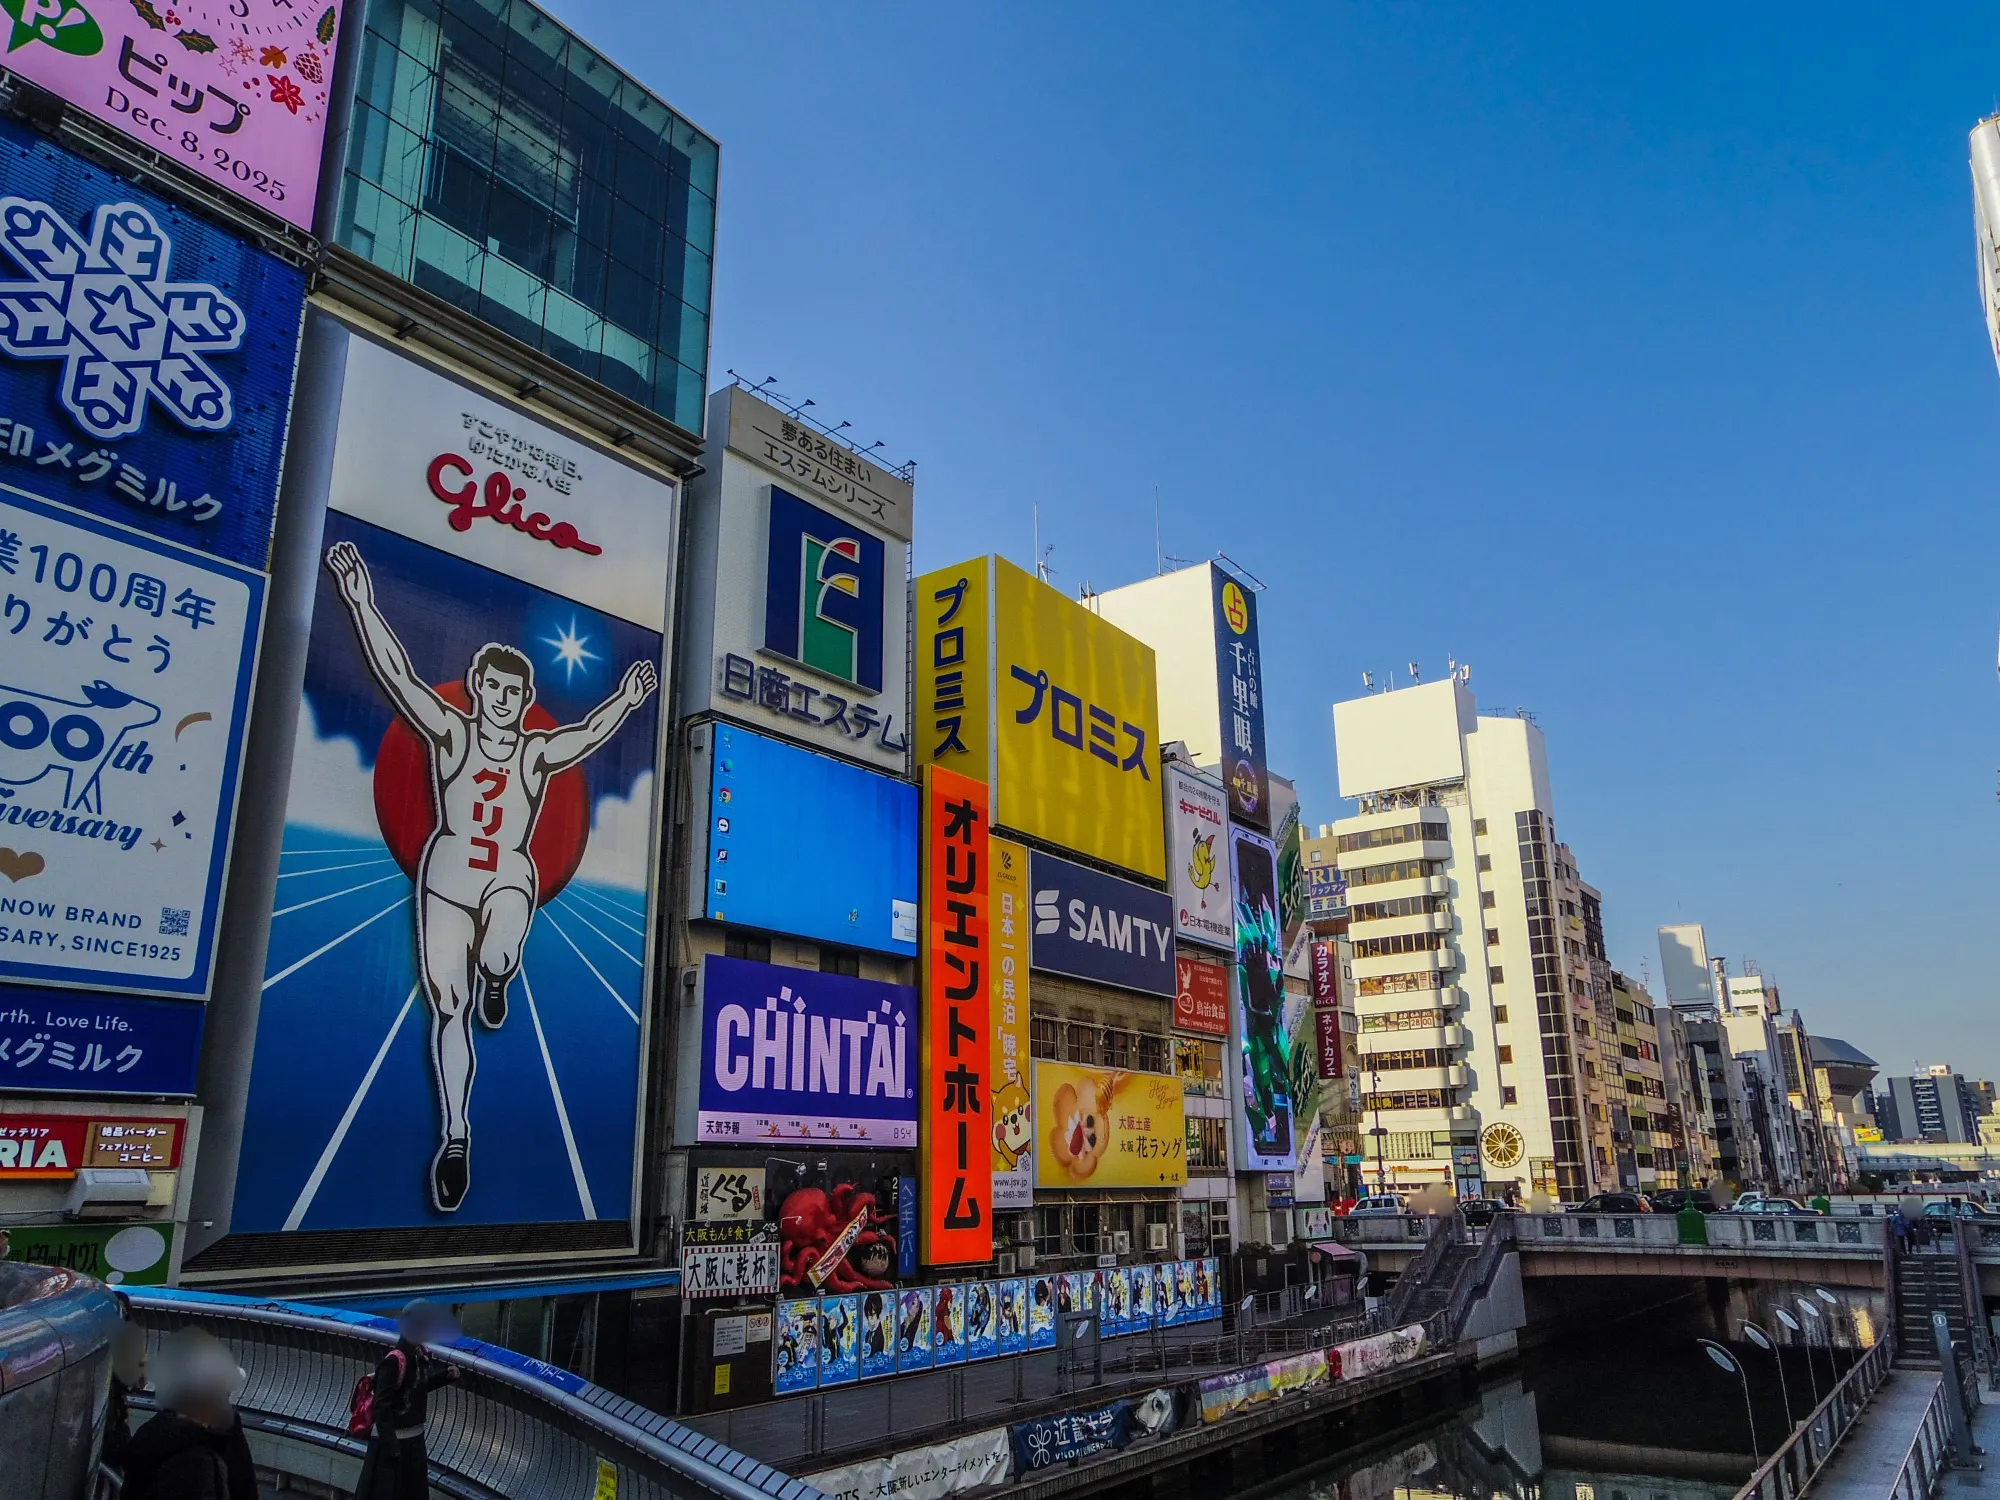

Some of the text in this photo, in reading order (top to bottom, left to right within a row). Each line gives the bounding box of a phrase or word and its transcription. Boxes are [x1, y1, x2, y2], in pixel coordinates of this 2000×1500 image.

[118, 35, 251, 134] ピップ
[105, 86, 287, 202] Dec. 8, 2025
[781, 420, 871, 482] 夢ある住まい
[764, 442, 885, 520] エステムシリーズ
[4, 593, 171, 674] りがとう
[934, 577, 968, 761] プロミス
[725, 653, 909, 752] 日商エステム
[1010, 664, 1151, 782] プロミス
[1229, 641, 1252, 756] 千里眼
[468, 767, 510, 872] グリコ
[1179, 797, 1221, 826] キュービクル
[1, 897, 142, 929] NOW BRAND
[1068, 899, 1171, 962] SAMTY
[1190, 914, 1232, 937] 日本電機産業
[1316, 944, 1328, 996] カラオケ
[46, 1011, 89, 1029] Love
[95, 1015, 133, 1032] Life.
[943, 798, 980, 1231] オリエントホーム
[715, 986, 906, 1099] CHINTAI
[1322, 1013, 1336, 1076] ネットカフェ
[99, 1142, 152, 1152] フェアトレード
[101, 1125, 167, 1138] 絶品バーガー
[706, 1120, 741, 1136] 天気予報
[1118, 1115, 1152, 1132] 大阪土産
[1119, 1135, 1183, 1159] 大阪 花ラング
[119, 1152, 164, 1164] コーヒー
[993, 1177, 1028, 1189] www.jsv.jp
[709, 1173, 752, 1213] くくる
[685, 1225, 755, 1243] 大阪もんを食す
[687, 1251, 767, 1290] 大阪に乾杯
